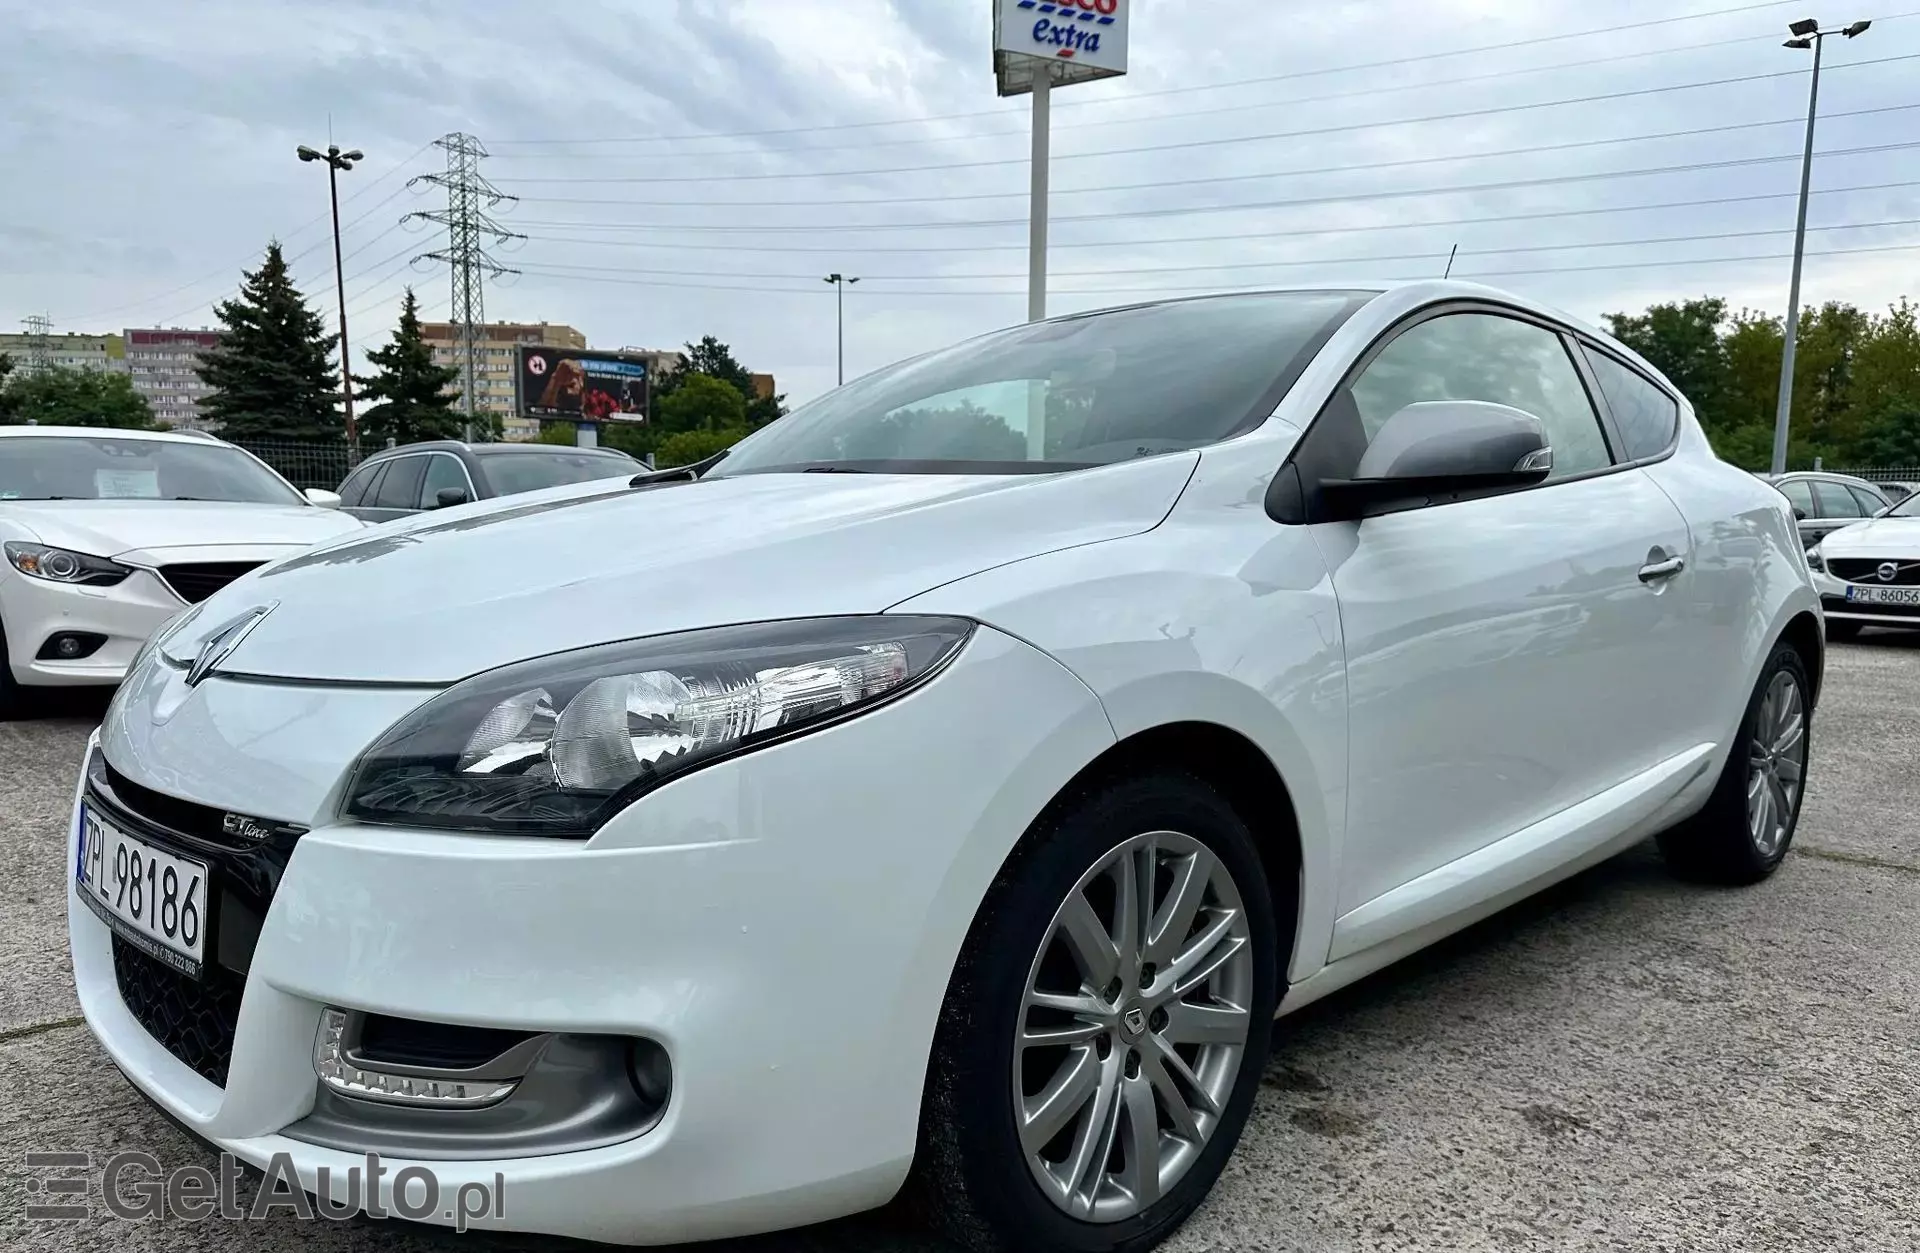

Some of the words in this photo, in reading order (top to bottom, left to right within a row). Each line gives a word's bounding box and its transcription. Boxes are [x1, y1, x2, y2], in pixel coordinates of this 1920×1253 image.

[1032, 18, 1101, 52] extra
[1853, 588, 1875, 601] ZPL
[1880, 590, 1919, 603] 86056
[84, 818, 110, 901] ZPL
[116, 842, 200, 947] 98186
